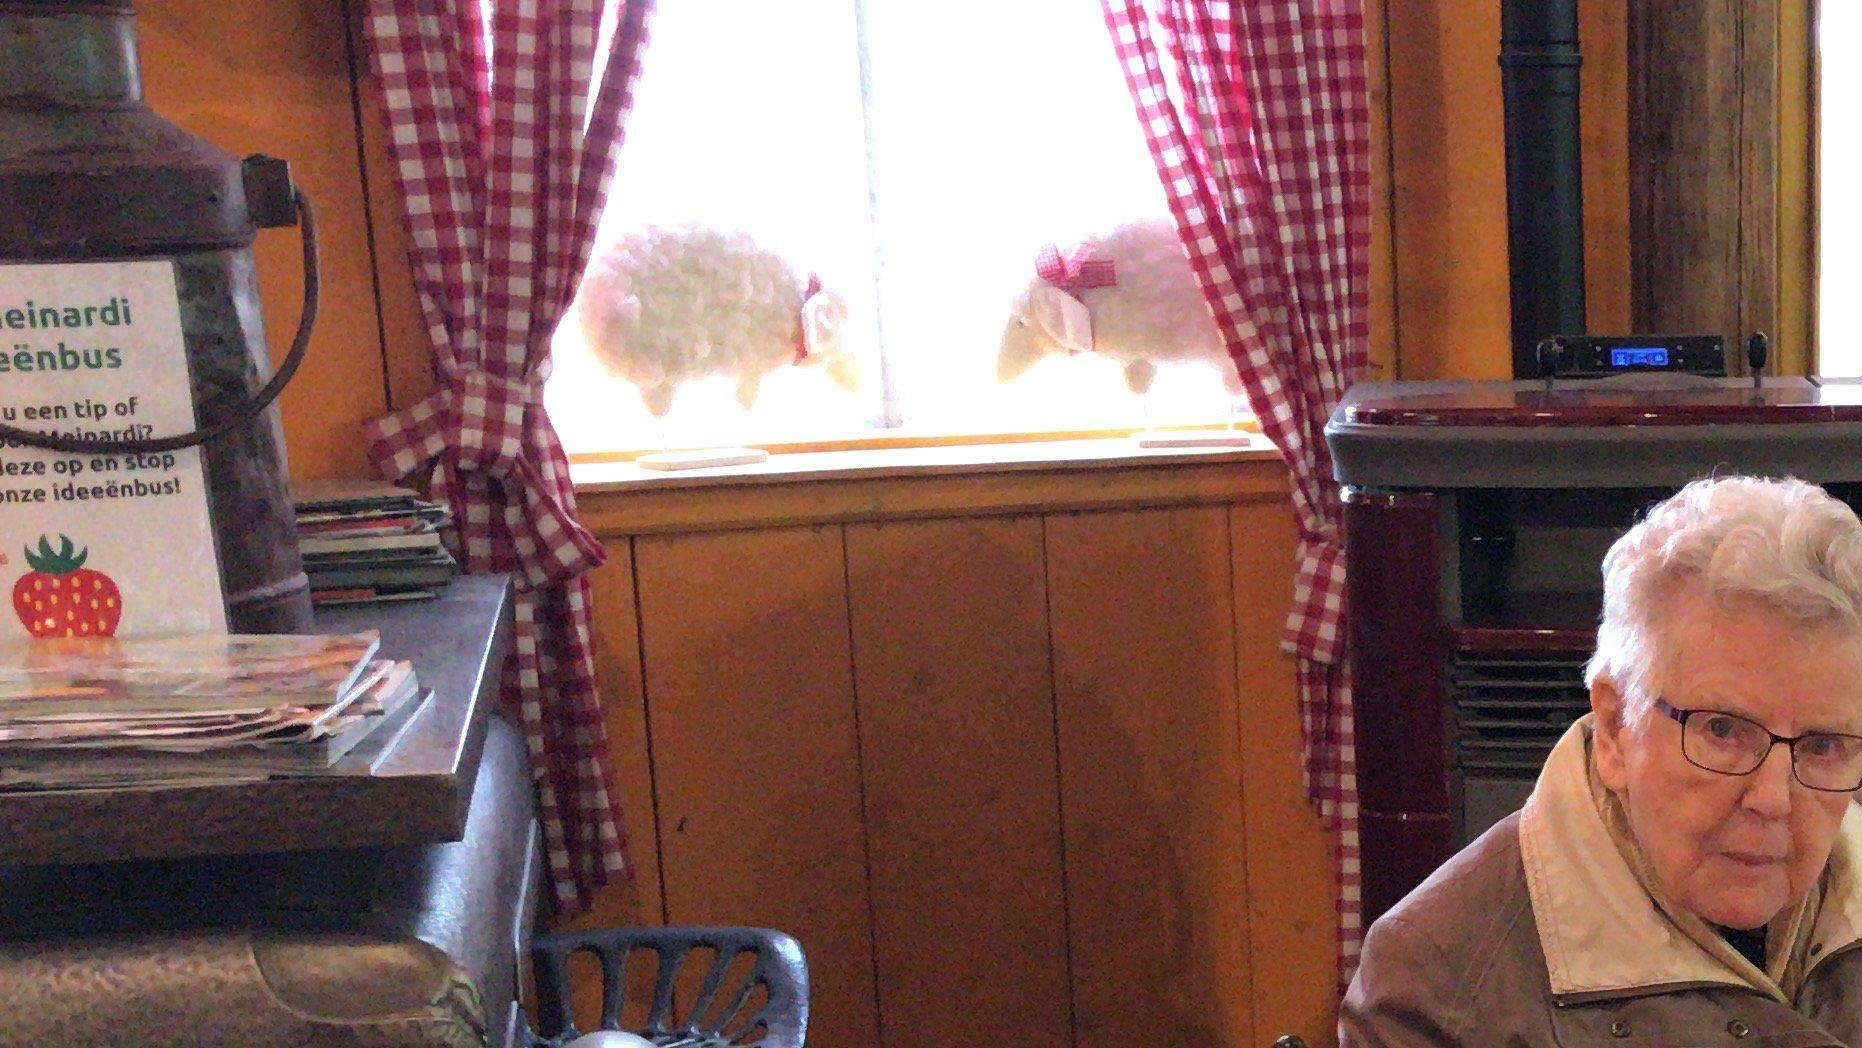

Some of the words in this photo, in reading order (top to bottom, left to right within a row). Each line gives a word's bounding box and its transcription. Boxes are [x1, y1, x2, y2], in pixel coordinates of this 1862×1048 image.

[0, 297, 131, 329] einardi
[3, 406, 16, 421] u
[24, 404, 67, 420] een
[74, 399, 108, 421] tip
[114, 396, 138, 416] of
[39, 423, 153, 445] einardi?
[0, 457, 46, 476] eze
[53, 459, 83, 477] op
[90, 456, 118, 472] en
[125, 452, 175, 472] stop
[53, 477, 182, 501] ideeënbus!
